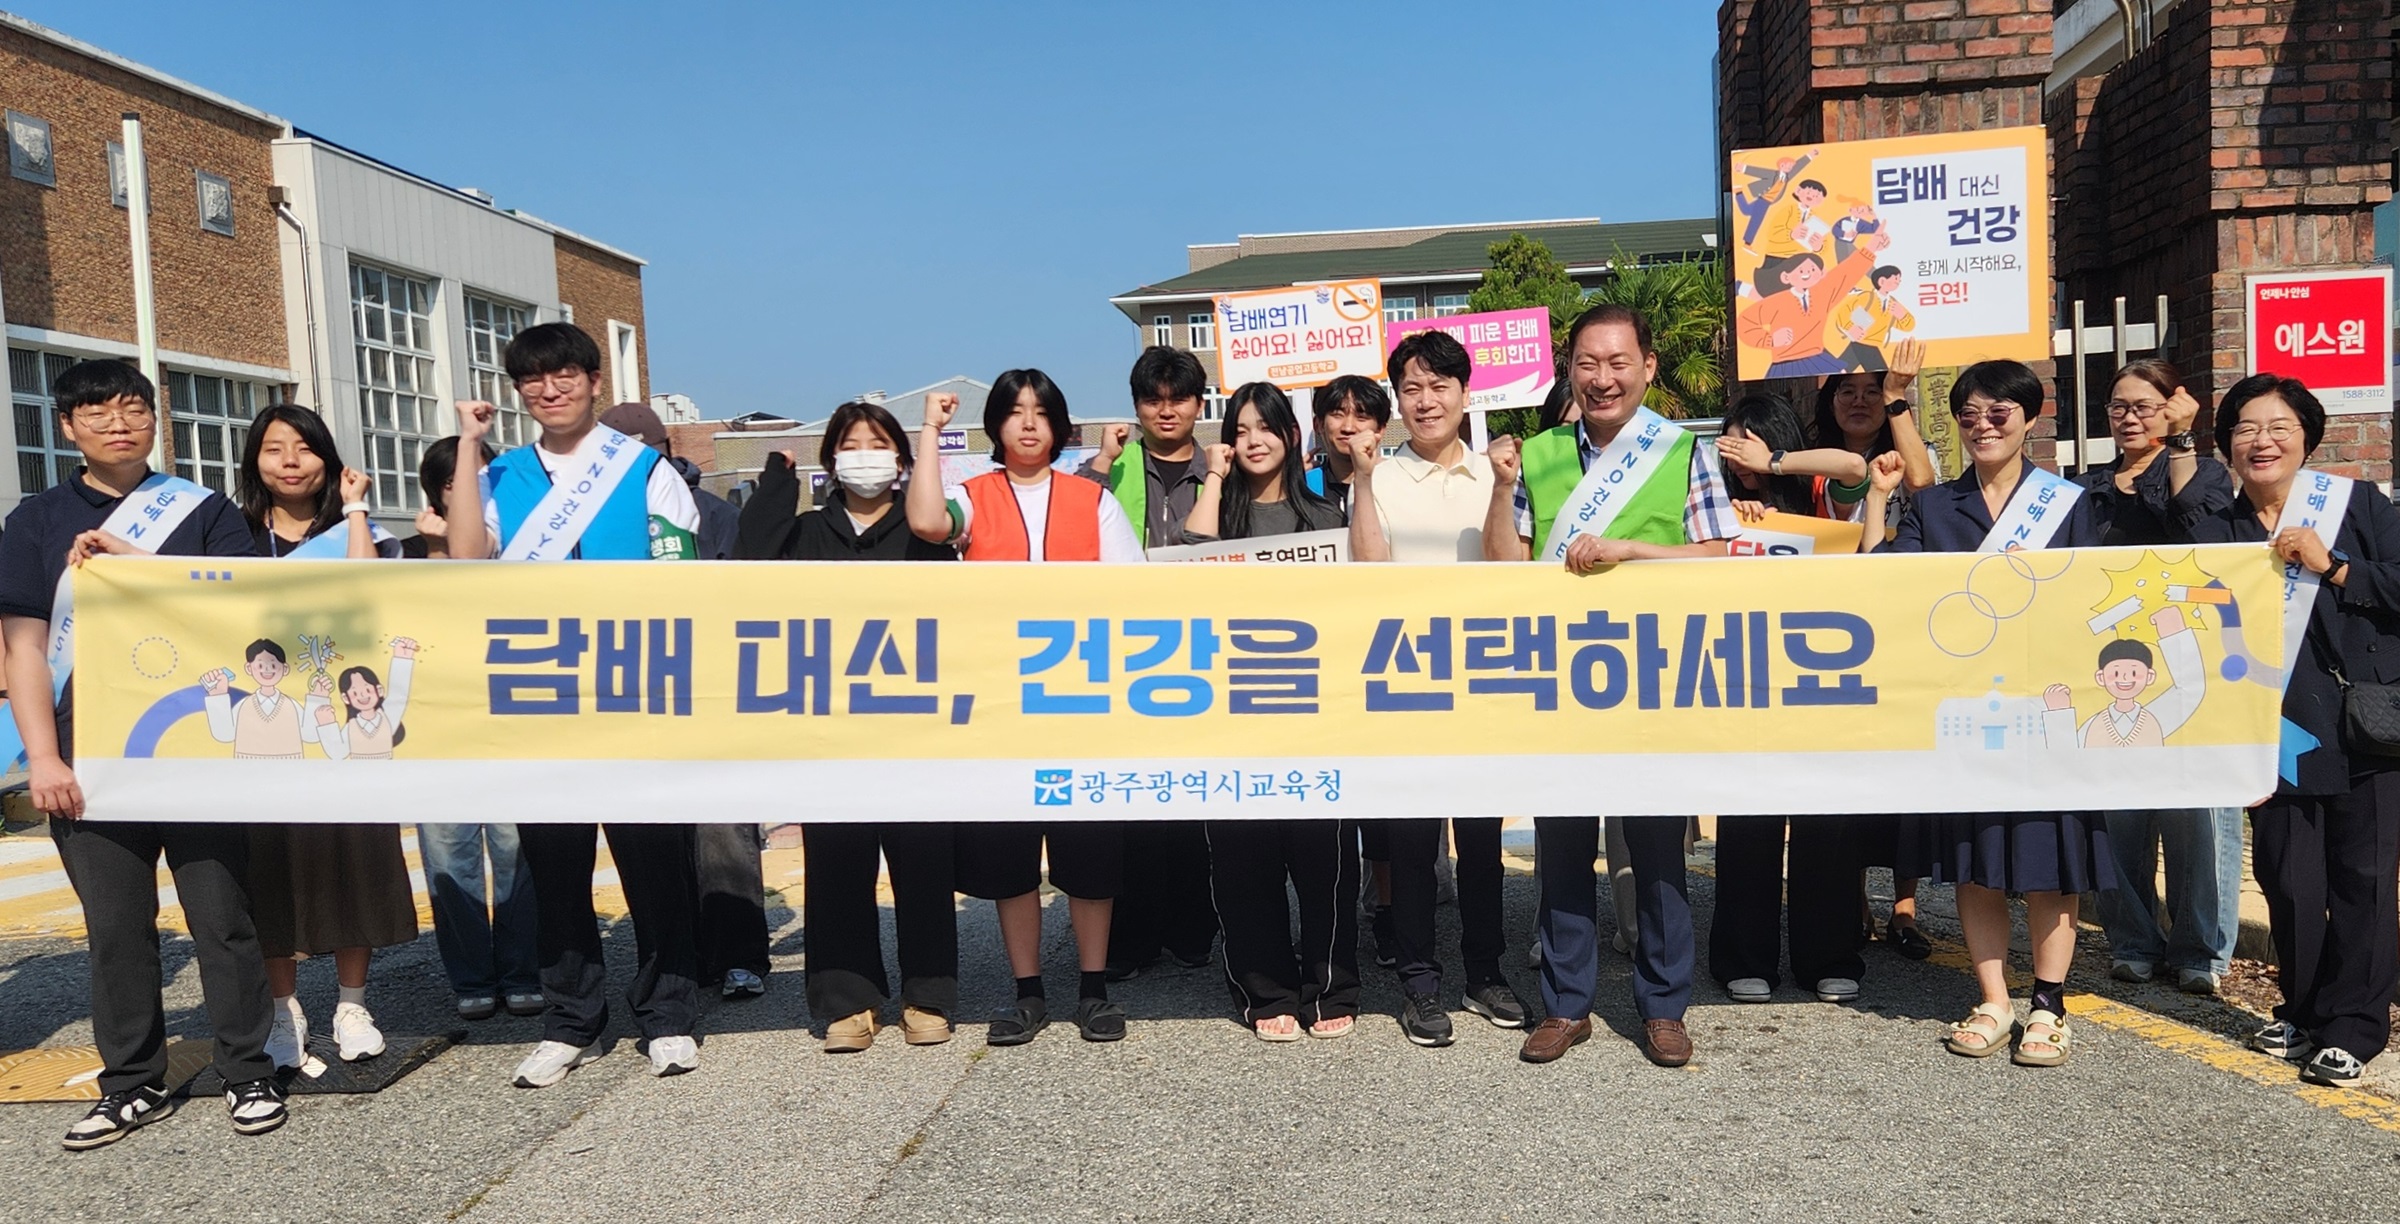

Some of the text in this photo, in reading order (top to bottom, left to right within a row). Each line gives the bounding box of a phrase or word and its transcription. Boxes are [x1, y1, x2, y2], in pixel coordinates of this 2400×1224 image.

[1877, 164, 2000, 205] 담배 대신
[1948, 205, 2020, 246] 건강
[1917, 254, 2021, 277] 함께 시작해요,
[1918, 282, 1968, 306] 금연!
[1227, 304, 1308, 333] 담배연기
[1469, 321, 1501, 344] 피운
[1506, 318, 1539, 341] 담배
[1230, 333, 1297, 360] 싫어요!
[1305, 325, 1372, 352] 싫어요!
[1475, 343, 1541, 367] 후회한다
[2274, 319, 2365, 357] 에스원
[1270, 361, 1335, 377] 전남공업고등학교
[2342, 389, 2385, 399] 1588-3112
[600, 433, 629, 461] 담배
[1636, 423, 1662, 451] 담배
[1579, 486, 1611, 522] 건강
[2027, 487, 2056, 522] 담배
[2307, 474, 2333, 512] 담배
[126, 491, 178, 539] 담배 N
[550, 498, 580, 531] 건강
[650, 536, 682, 557] 생회
[1555, 523, 1581, 558] YE
[55, 609, 74, 652] ES
[485, 610, 1878, 725] 담배 대신, 건강을 선택하세요
[1079, 769, 1342, 803] 광주광역시교육청
